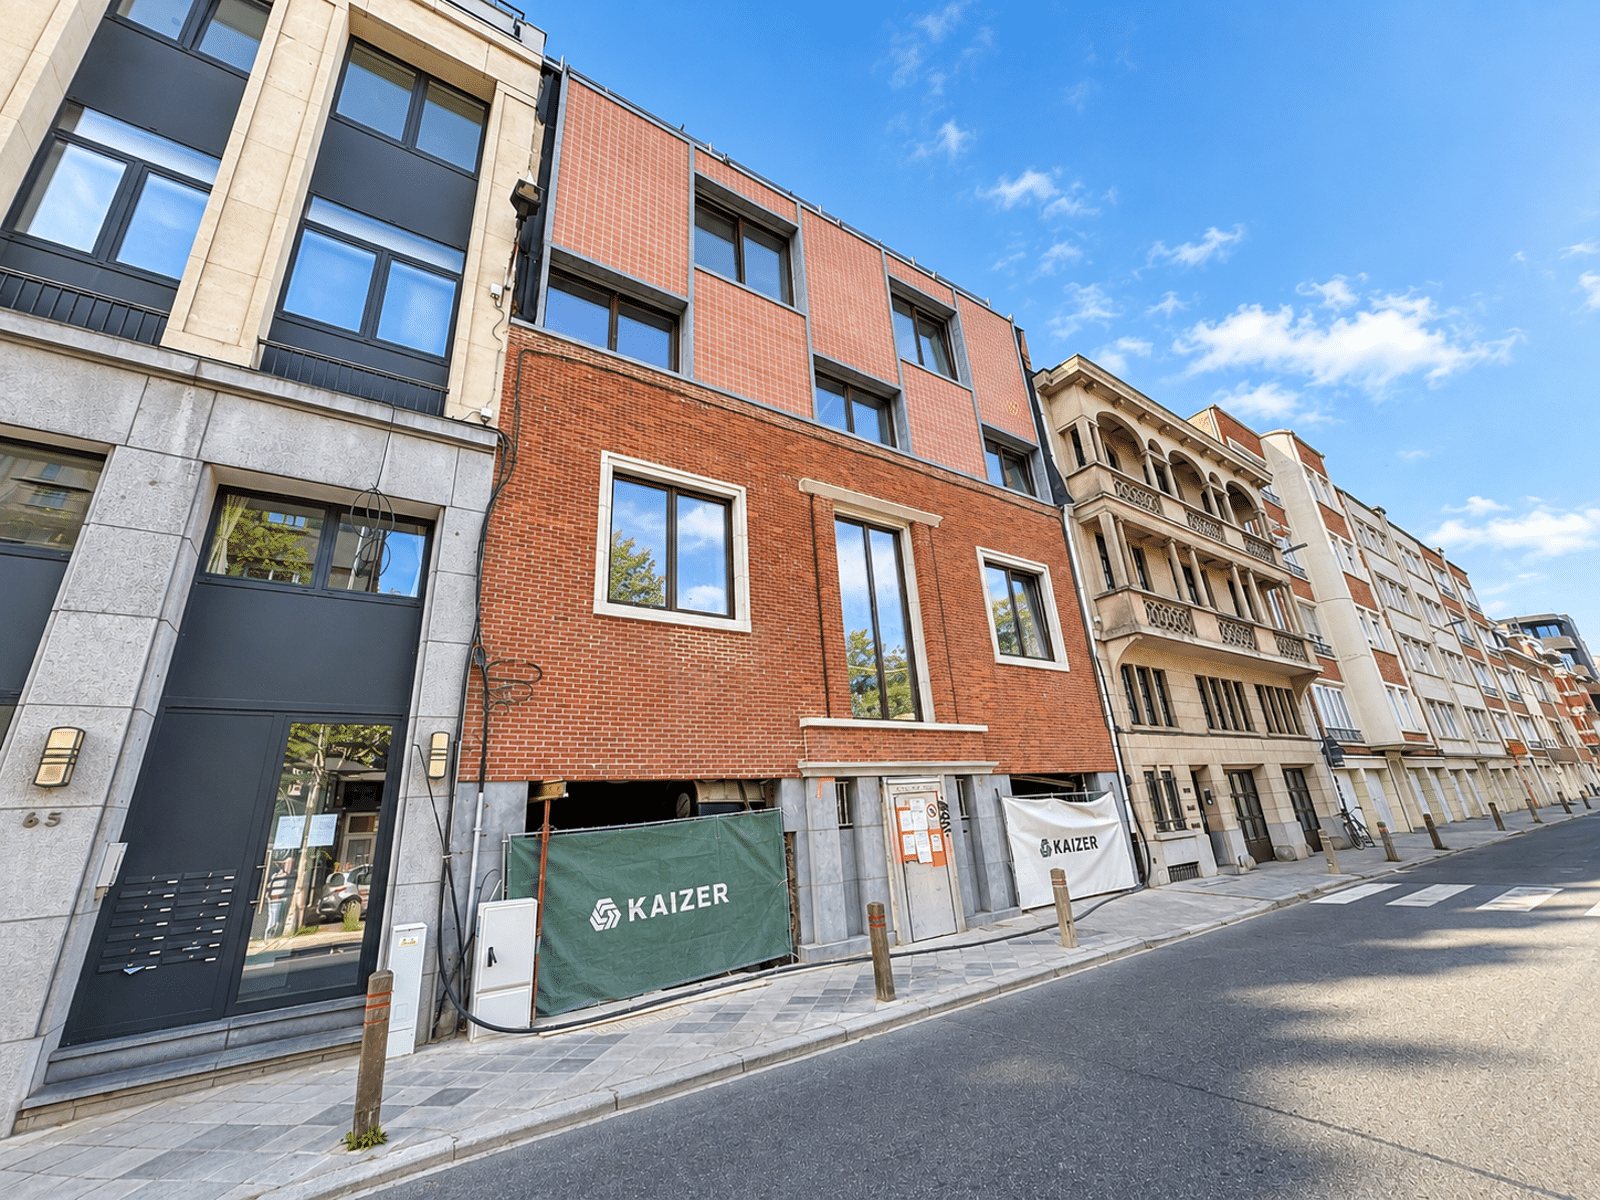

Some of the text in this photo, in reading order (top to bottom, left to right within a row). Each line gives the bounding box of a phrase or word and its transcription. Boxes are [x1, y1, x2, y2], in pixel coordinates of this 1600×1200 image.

[22, 811, 62, 829] 65
[1053, 836, 1099, 854] KAIZER
[628, 883, 730, 922] KAIZER
